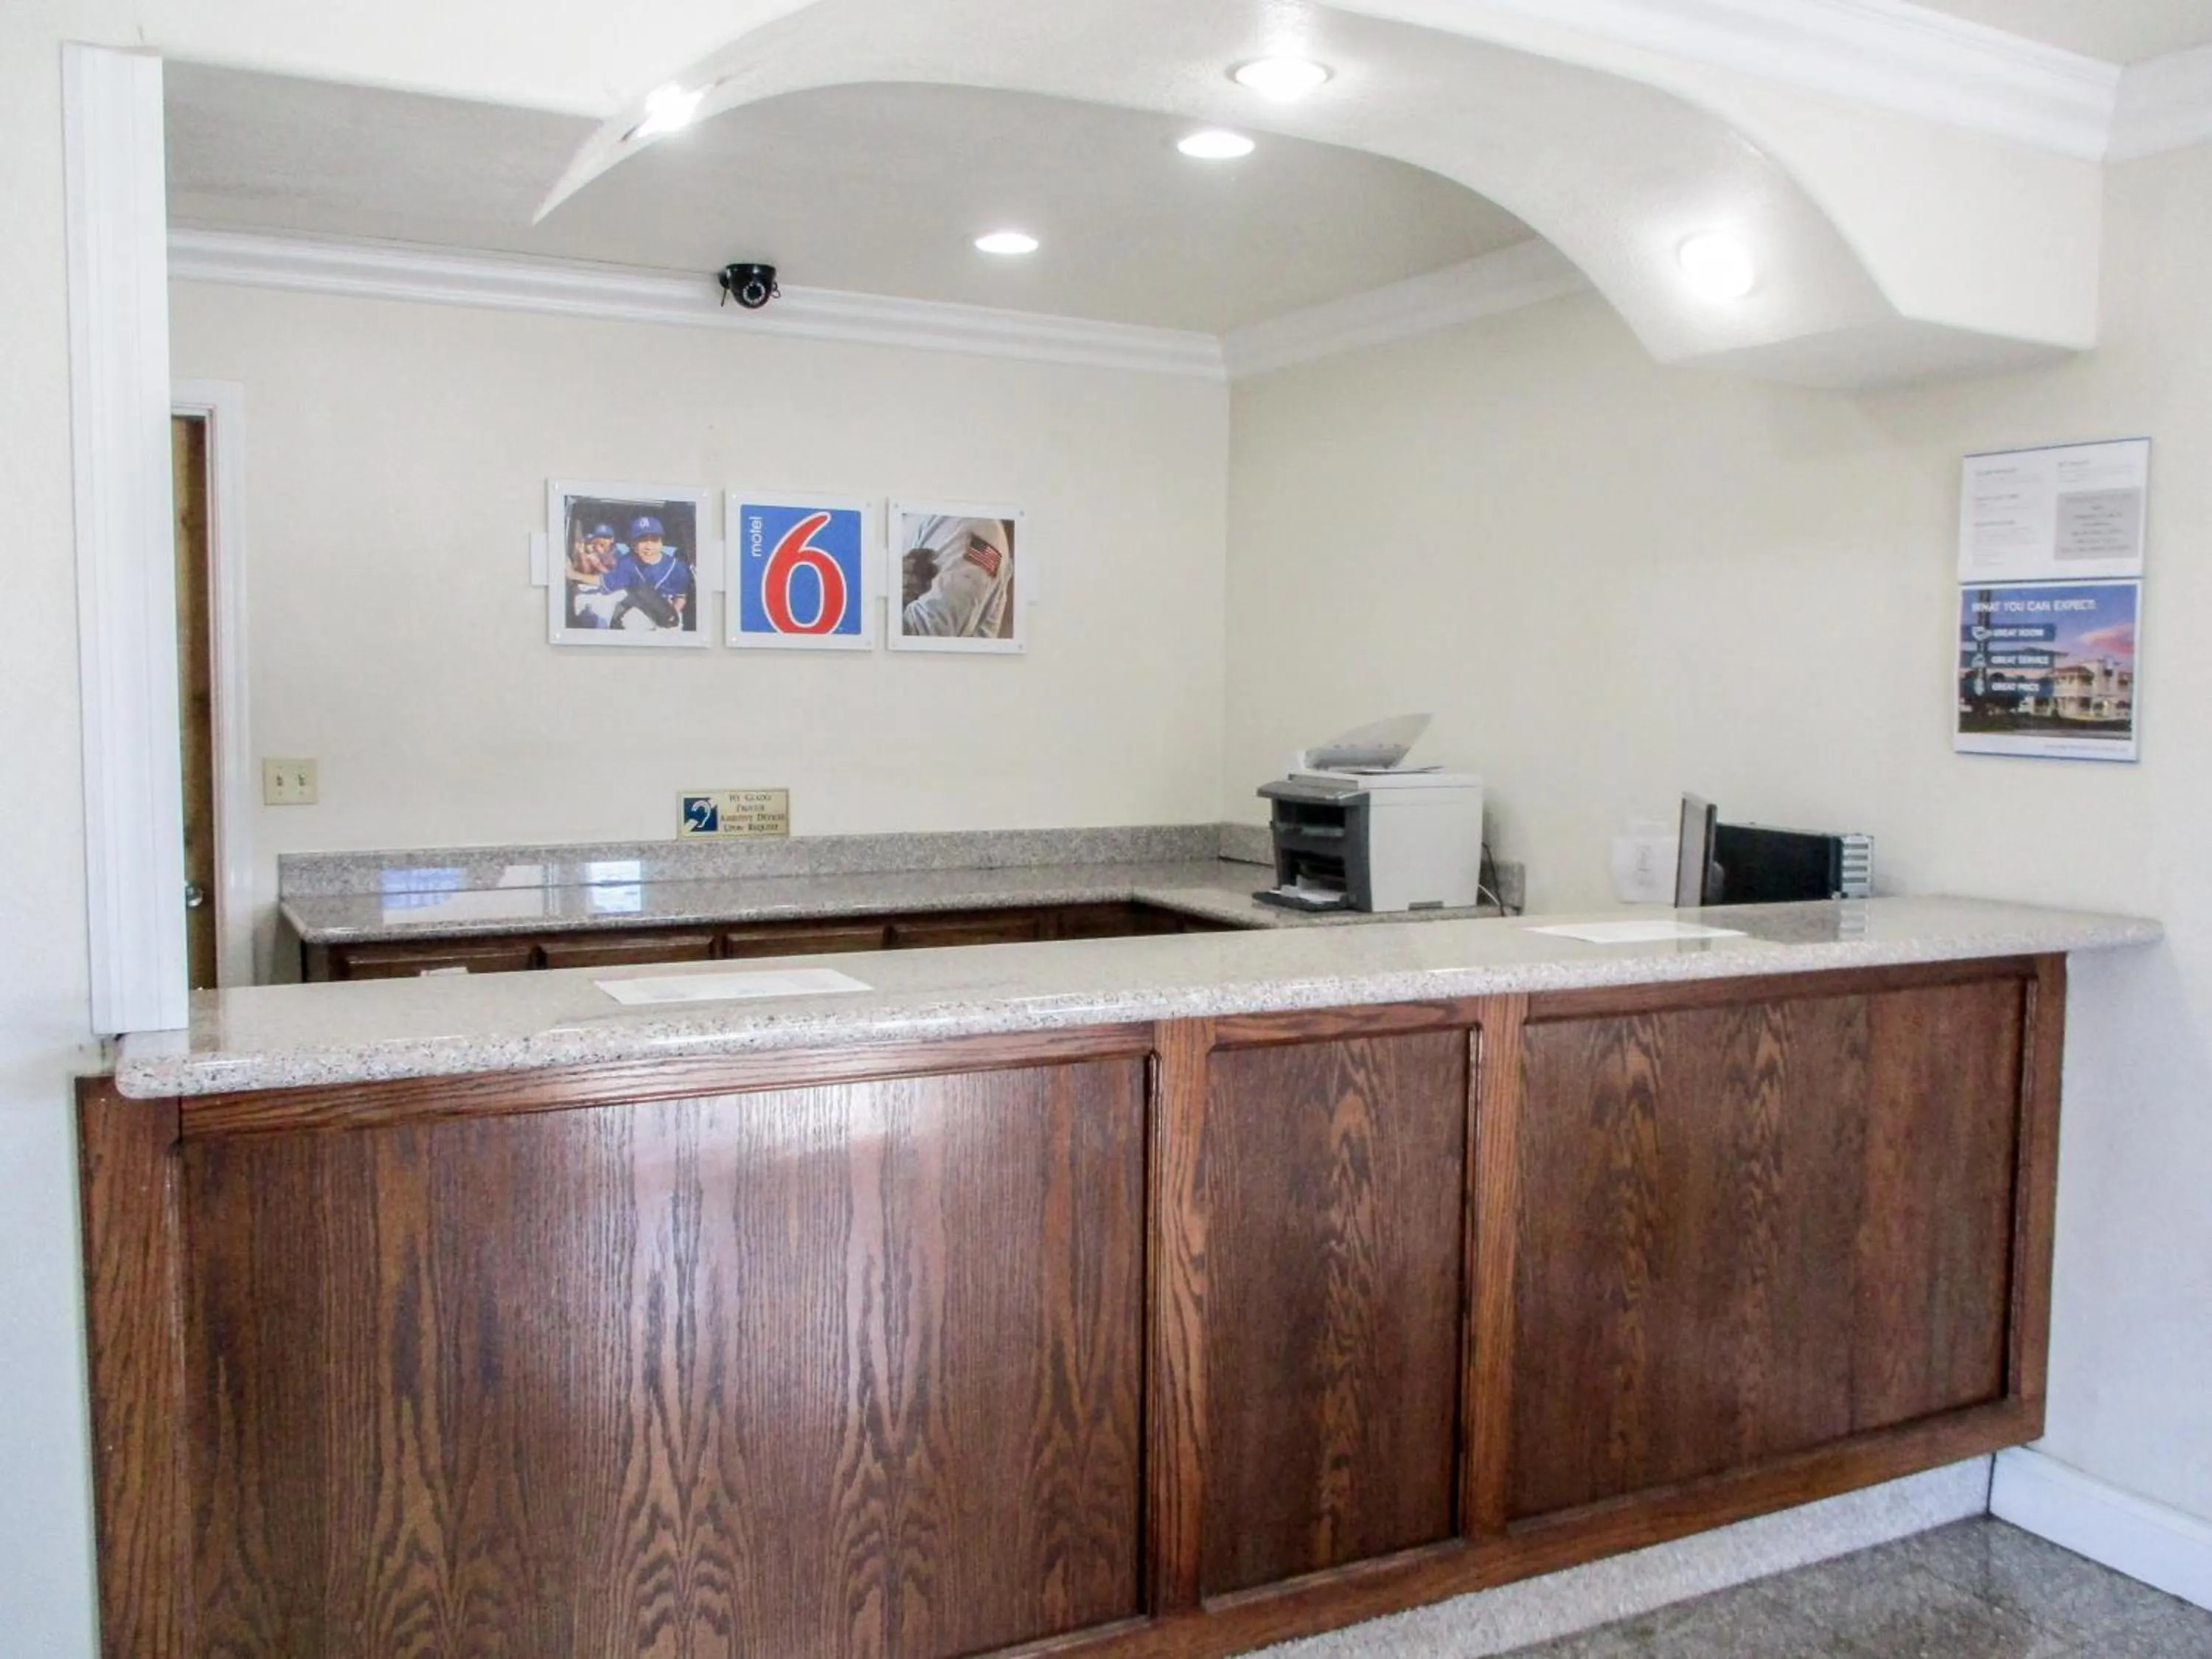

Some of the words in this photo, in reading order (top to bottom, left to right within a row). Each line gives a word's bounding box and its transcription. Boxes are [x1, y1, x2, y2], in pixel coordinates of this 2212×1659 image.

[749, 516, 762, 557] motel
[761, 511, 846, 634] 6
[1971, 602, 2000, 612] WHAT
[2004, 600, 2025, 611] YOU
[2027, 599, 2051, 611] CAN
